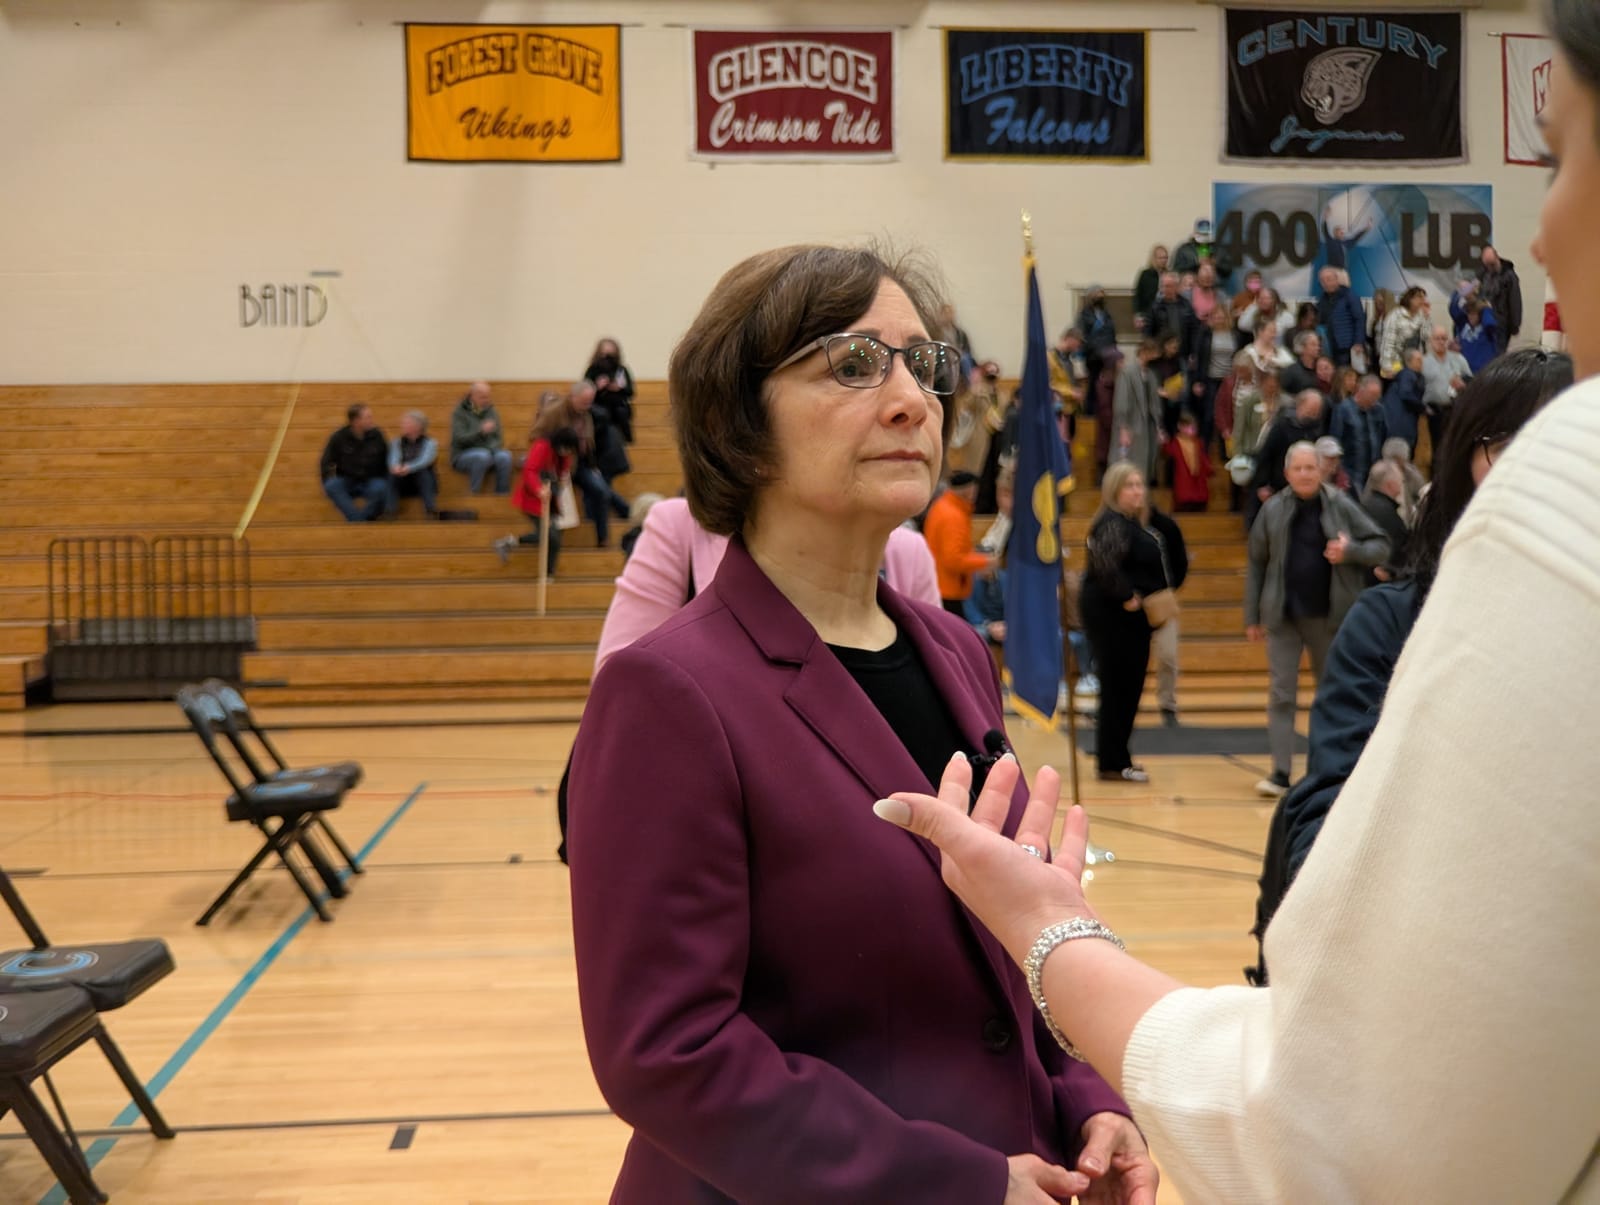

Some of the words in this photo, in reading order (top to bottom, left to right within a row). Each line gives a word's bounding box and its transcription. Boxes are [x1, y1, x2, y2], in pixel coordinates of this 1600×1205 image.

[425, 32, 519, 96] FOREST
[523, 32, 603, 96] GROVE
[1236, 16, 1449, 69] CENTURY
[708, 41, 878, 105] GLENCOE
[960, 43, 1134, 107] LIBERTY
[459, 105, 573, 153] Vikings
[709, 100, 823, 149] Crimson
[823, 99, 882, 145] Tide
[984, 95, 1110, 145] Falcons
[1214, 208, 1320, 269] 400
[239, 283, 328, 328] BAND
